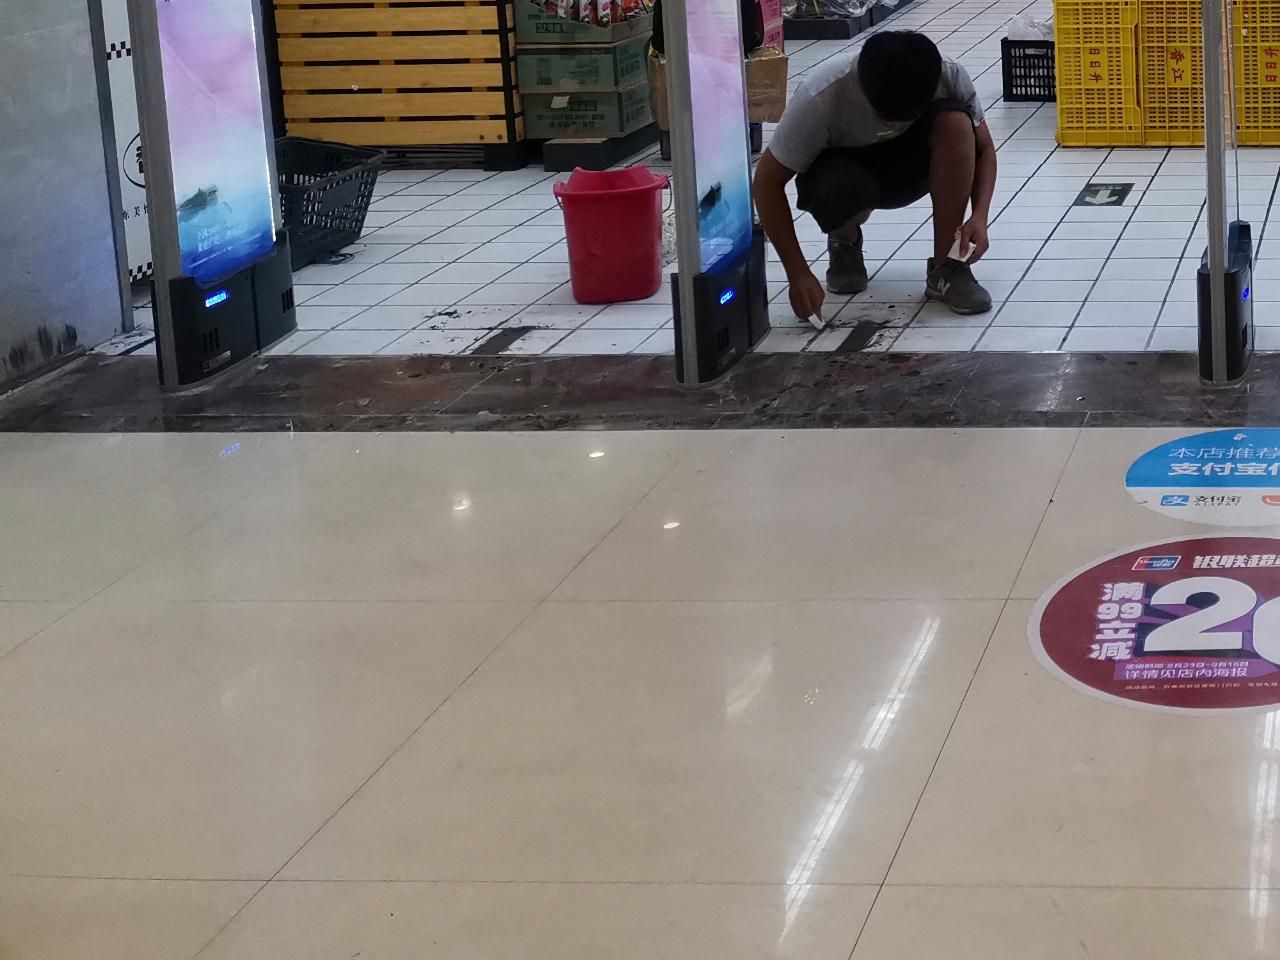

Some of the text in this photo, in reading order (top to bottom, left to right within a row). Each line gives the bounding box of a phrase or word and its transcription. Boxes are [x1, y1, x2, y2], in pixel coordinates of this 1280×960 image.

[1168, 47, 1185, 83] 香江
[1194, 495, 1242, 504] 支付宝
[1089, 581, 1145, 661] 满99立减
[1124, 668, 1249, 680] 详情见店内海报
